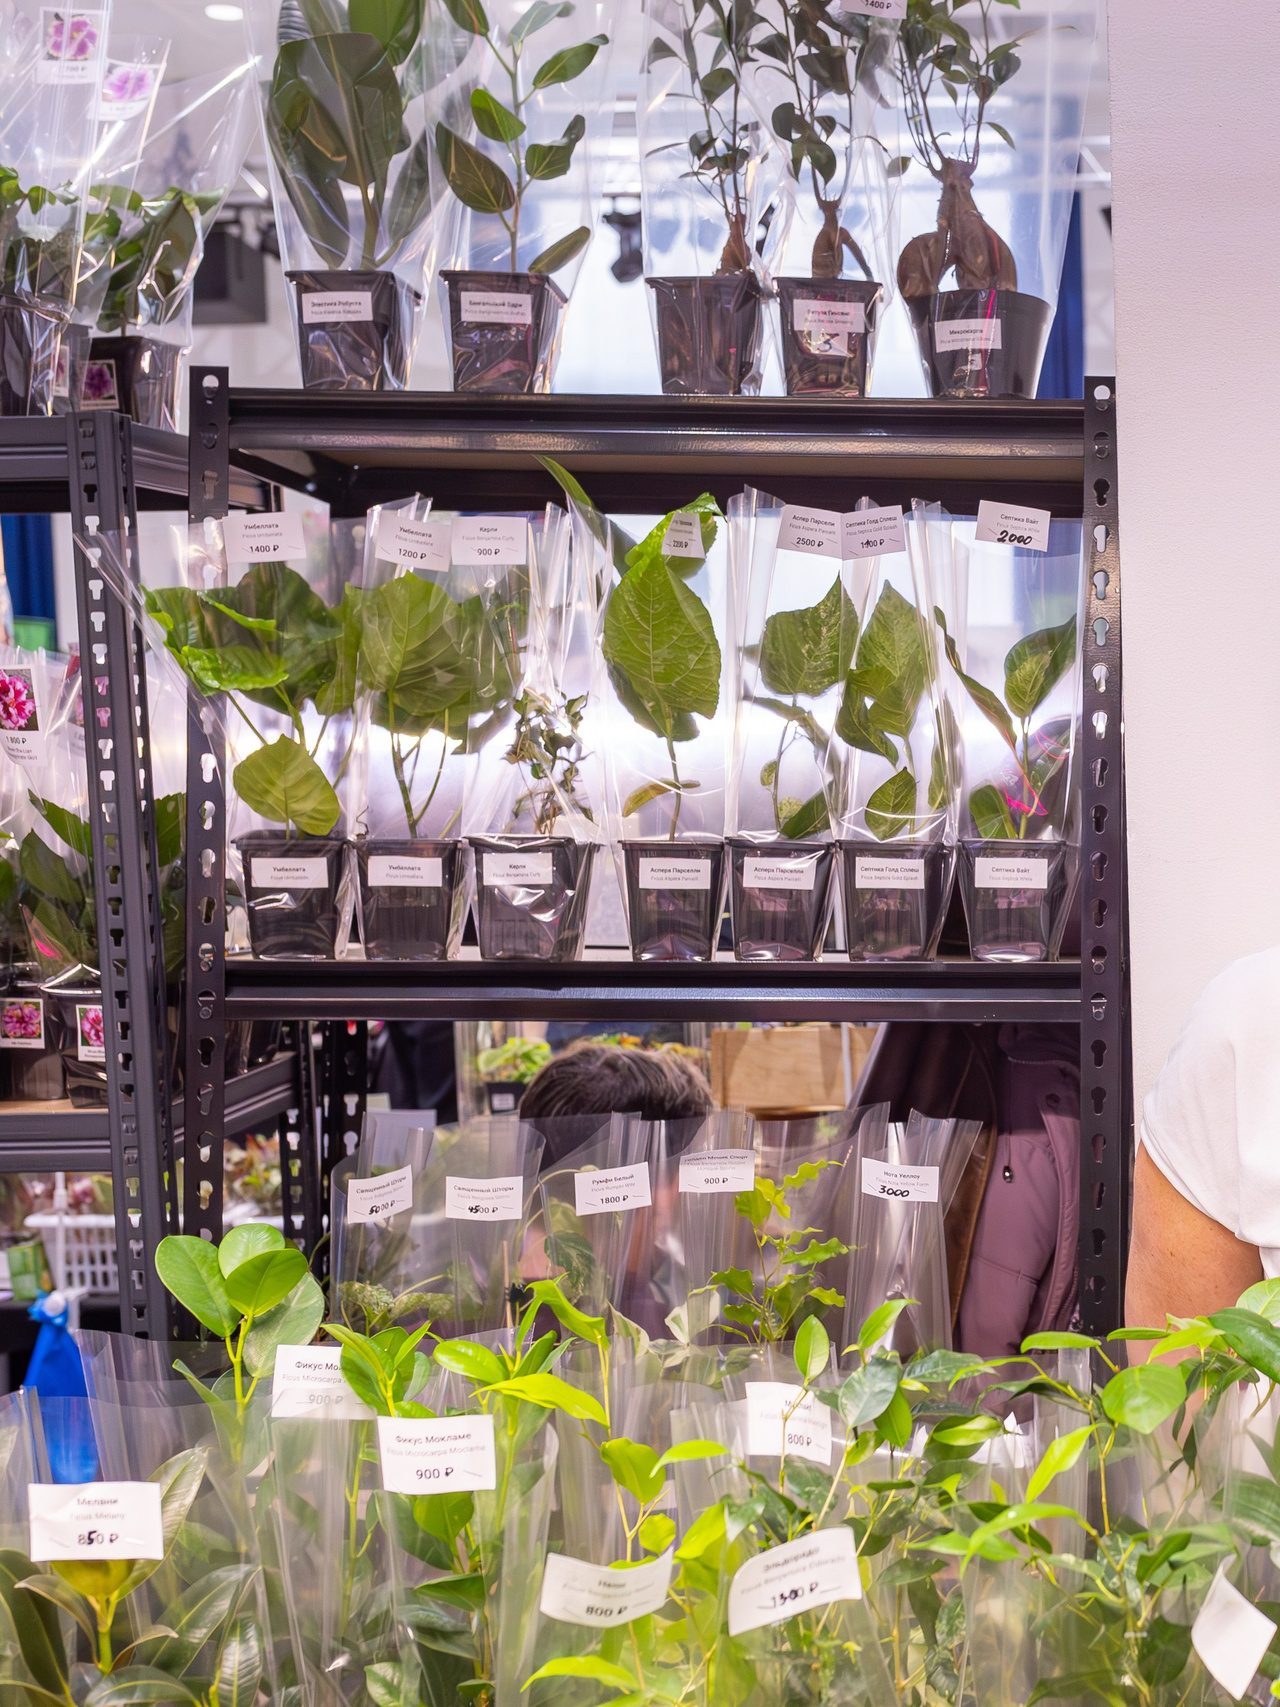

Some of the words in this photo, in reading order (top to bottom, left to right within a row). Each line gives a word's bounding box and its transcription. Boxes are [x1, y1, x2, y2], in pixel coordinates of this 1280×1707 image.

[792, 514, 809, 523] Аспер
[810, 517, 835, 527] Парсели
[1000, 513, 1024, 523] Септика
[399, 526, 432, 538] Умбеллата
[996, 530, 1032, 545] 2000
[796, 537, 816, 547] 2500
[398, 548, 418, 559] 1200
[477, 548, 492, 556] 900
[754, 866, 775, 874] Аспера
[592, 1177, 613, 1186] Румфи
[614, 1174, 634, 1182] Белый
[704, 1177, 720, 1185] 900
[453, 1185, 491, 1193] Священный
[879, 1185, 910, 1197] 3000
[600, 1196, 620, 1204] 1800
[295, 1361, 322, 1372] Фикус
[309, 1394, 329, 1405] 900
[396, 1435, 424, 1445] Фикус
[425, 1433, 472, 1445] Мокламе
[787, 1433, 804, 1446] 800
[416, 1469, 440, 1480] 900
[78, 1530, 104, 1545] 850
[585, 1606, 613, 1617] 800
